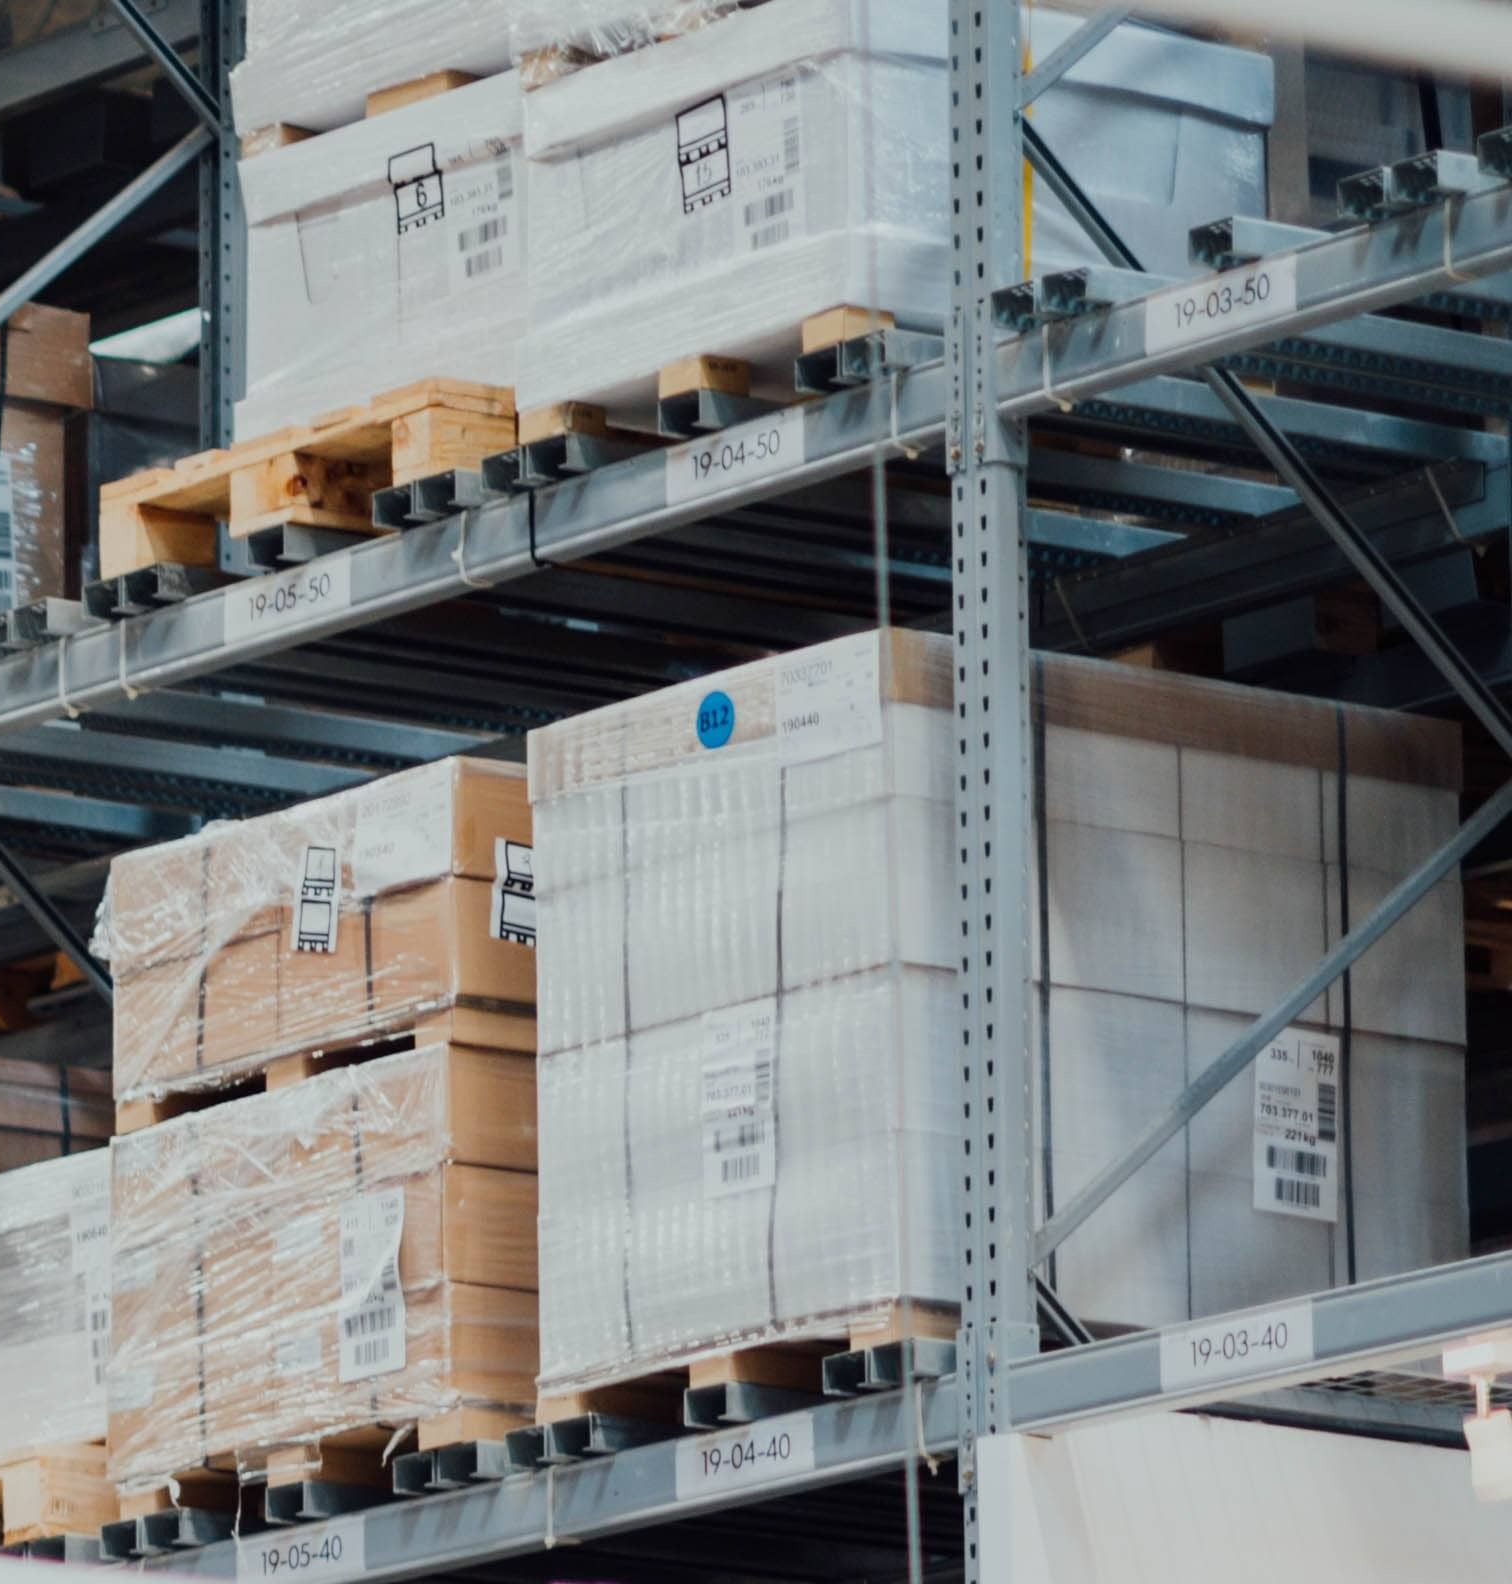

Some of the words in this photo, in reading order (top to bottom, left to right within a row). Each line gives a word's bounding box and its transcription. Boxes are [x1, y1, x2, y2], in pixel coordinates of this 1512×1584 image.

[415, 183, 428, 209] 6
[1173, 272, 1272, 330] 19-03-50
[690, 429, 782, 483] 19-04-50
[247, 572, 333, 622] 19-05-50
[700, 704, 730, 733] B12
[781, 711, 821, 734] 190440
[1189, 1322, 1289, 1367] 19-03-40
[701, 1433, 792, 1477] 19-04-40
[260, 1535, 343, 1577] 19-05-40
